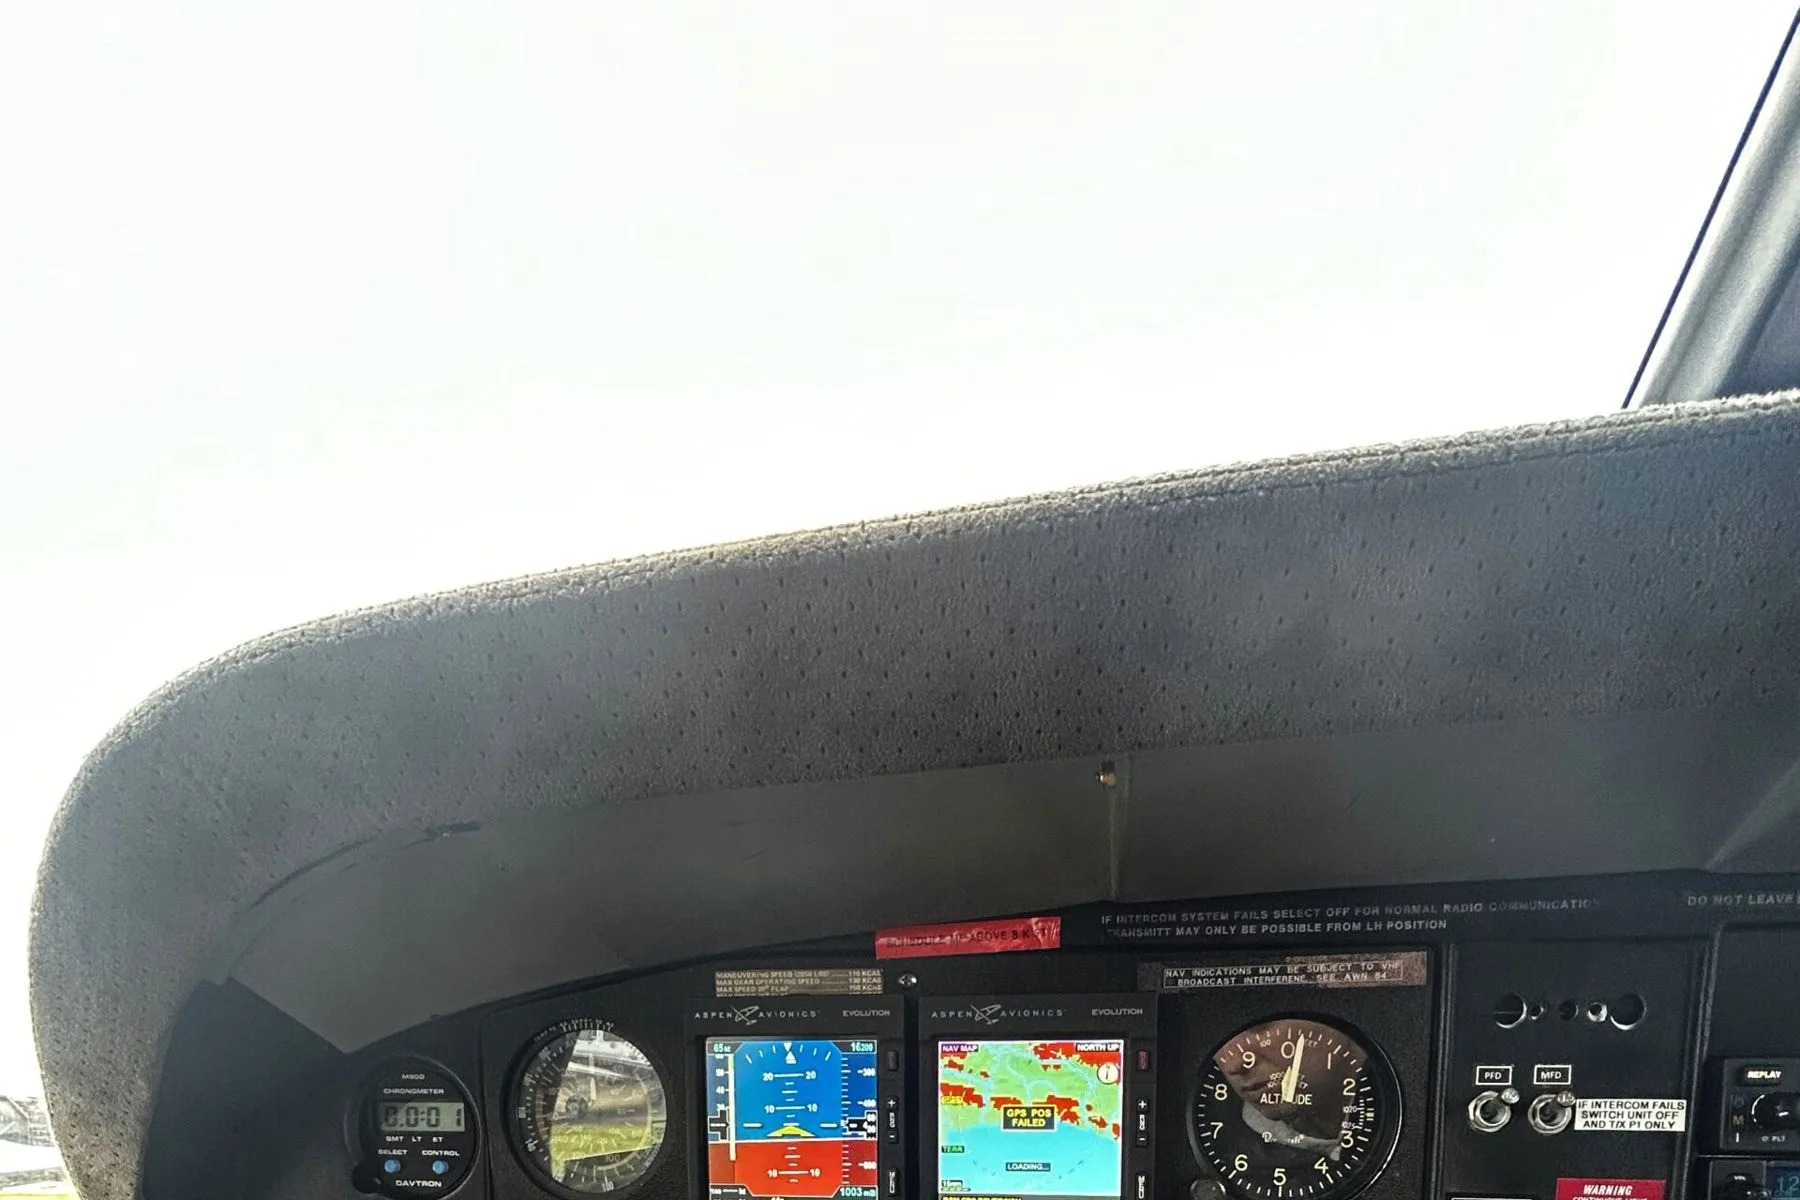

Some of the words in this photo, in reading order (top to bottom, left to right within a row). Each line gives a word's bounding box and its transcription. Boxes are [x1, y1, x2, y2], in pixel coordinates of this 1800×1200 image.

[1101, 915, 1112, 924] IF
[1117, 913, 1176, 923] INTERCOM
[1181, 912, 1229, 922] SYSTEM
[1234, 910, 1268, 920] FAILS
[1274, 908, 1319, 919] SELECT
[1326, 908, 1349, 916] OFF
[1355, 907, 1379, 916] FOR
[1385, 903, 1437, 915] NORMAL
[1443, 902, 1483, 913] RADIO
[1176, 926, 1200, 936] MAY
[1205, 926, 1236, 935] ONLY
[1242, 925, 1256, 934] BE
[1262, 923, 1321, 933] POSSIBLE
[1327, 922, 1361, 932] FROM
[1367, 921, 1382, 930] LH
[1388, 919, 1447, 930] POSITION
[1165, 969, 1185, 978] NAV
[1192, 967, 1251, 977] INDICATIONS
[1259, 965, 1279, 974] MAY
[1288, 965, 1299, 973] BE
[1307, 964, 1351, 972] SUBJECT
[1361, 963, 1374, 971] TO
[758, 1010, 816, 1018] AVIONICS
[843, 1009, 890, 1017] EVOLUTION
[931, 1010, 972, 1018] ASPEN
[1001, 1009, 1062, 1017] AVIONICS
[1092, 1008, 1143, 1016] EVOLUTION
[851, 1043, 873, 1051] 16200
[1243, 1052, 1255, 1068] 9
[1484, 1072, 1502, 1080] PFD
[1541, 1071, 1562, 1080] MFD
[1214, 1084, 1228, 1100] 8
[1343, 1079, 1355, 1095] 2
[1579, 1101, 1589, 1110] IF
[1591, 1101, 1650, 1110] INTERCOM
[1652, 1101, 1685, 1111] FAILS
[1007, 1109, 1026, 1117] GPS
[1031, 1109, 1052, 1117] POS
[1581, 1111, 1626, 1119] SWITCH
[1628, 1111, 1654, 1119] UNIT
[1656, 1111, 1679, 1120] OFF
[1012, 1118, 1045, 1127] FAILED
[1583, 1120, 1607, 1129] AND
[1610, 1120, 1626, 1129] T/X
[1629, 1120, 1641, 1129] P1
[1645, 1121, 1675, 1129] ONLY
[1210, 1122, 1223, 1139] 7
[1341, 1130, 1354, 1148] 3
[1235, 1155, 1248, 1171] 6
[1314, 1157, 1328, 1174] 4
[1274, 1168, 1286, 1185] 5
[1583, 1184, 1632, 1196] WARNING
